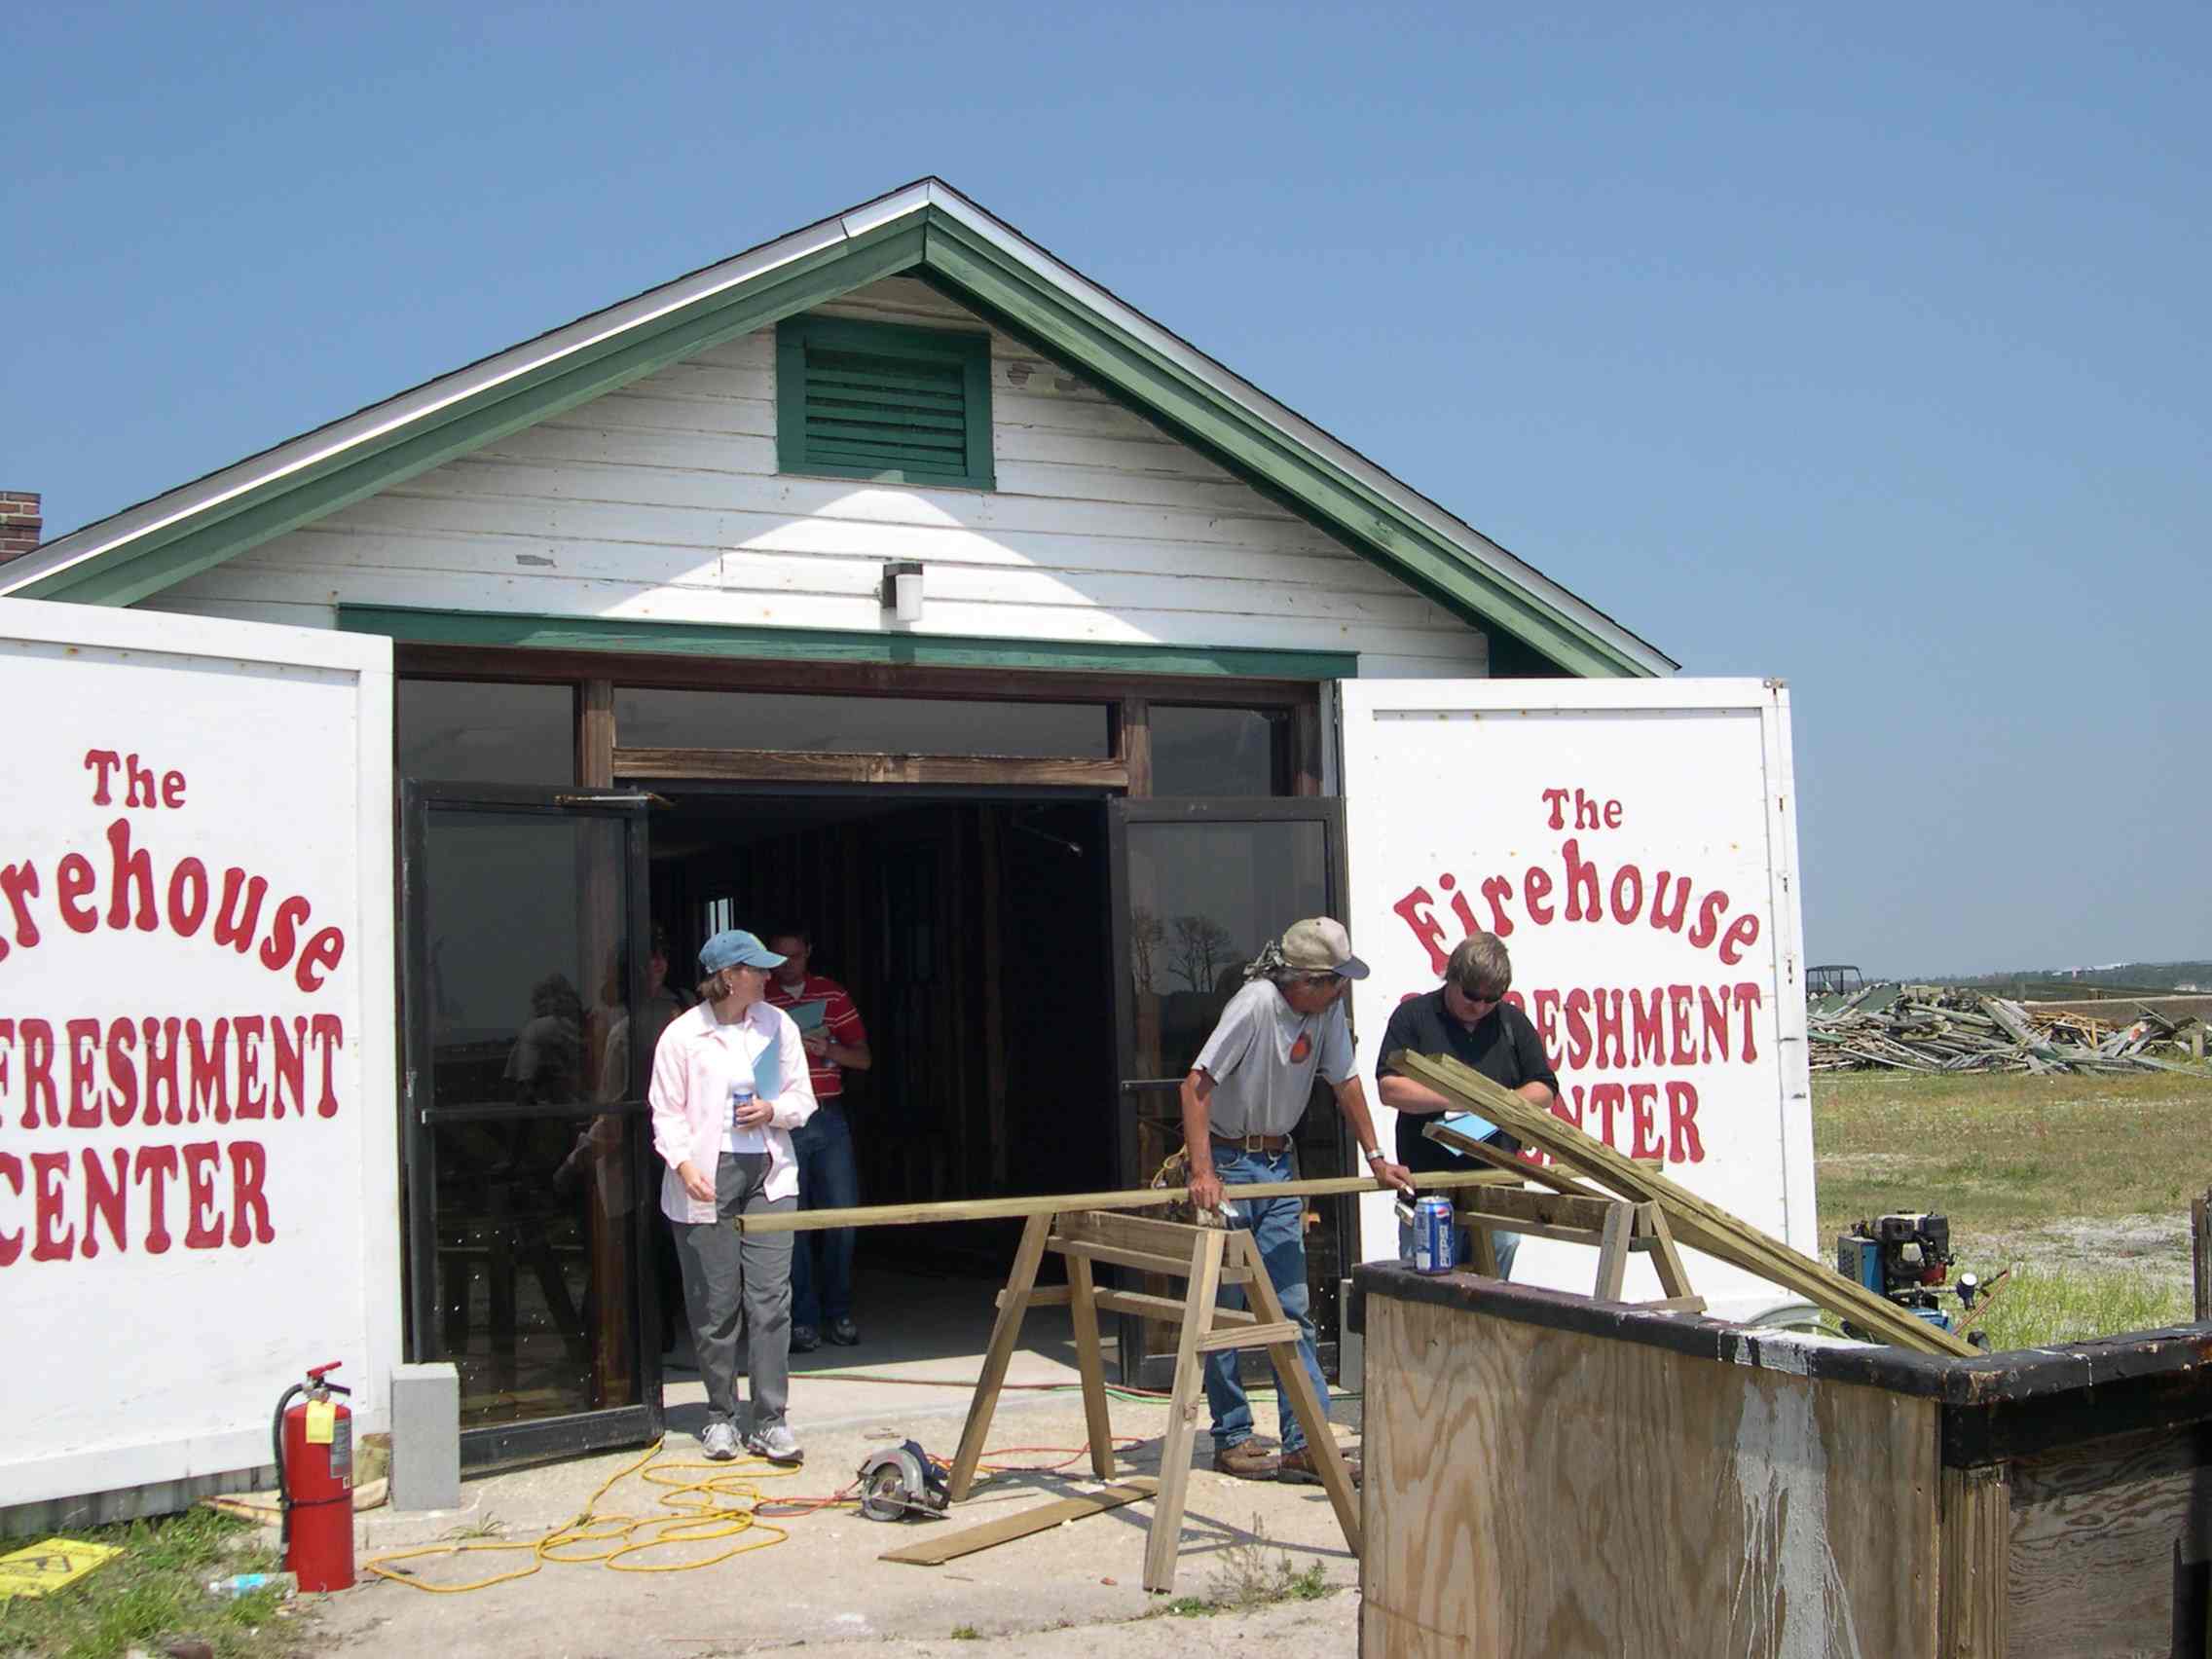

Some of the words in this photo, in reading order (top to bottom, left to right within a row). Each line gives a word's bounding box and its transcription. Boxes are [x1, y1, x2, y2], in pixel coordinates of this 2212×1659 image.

[83, 748, 187, 809] The
[1541, 788, 1623, 830] The
[0, 817, 345, 993] rehouse
[1392, 837, 1759, 976] Firehouse
